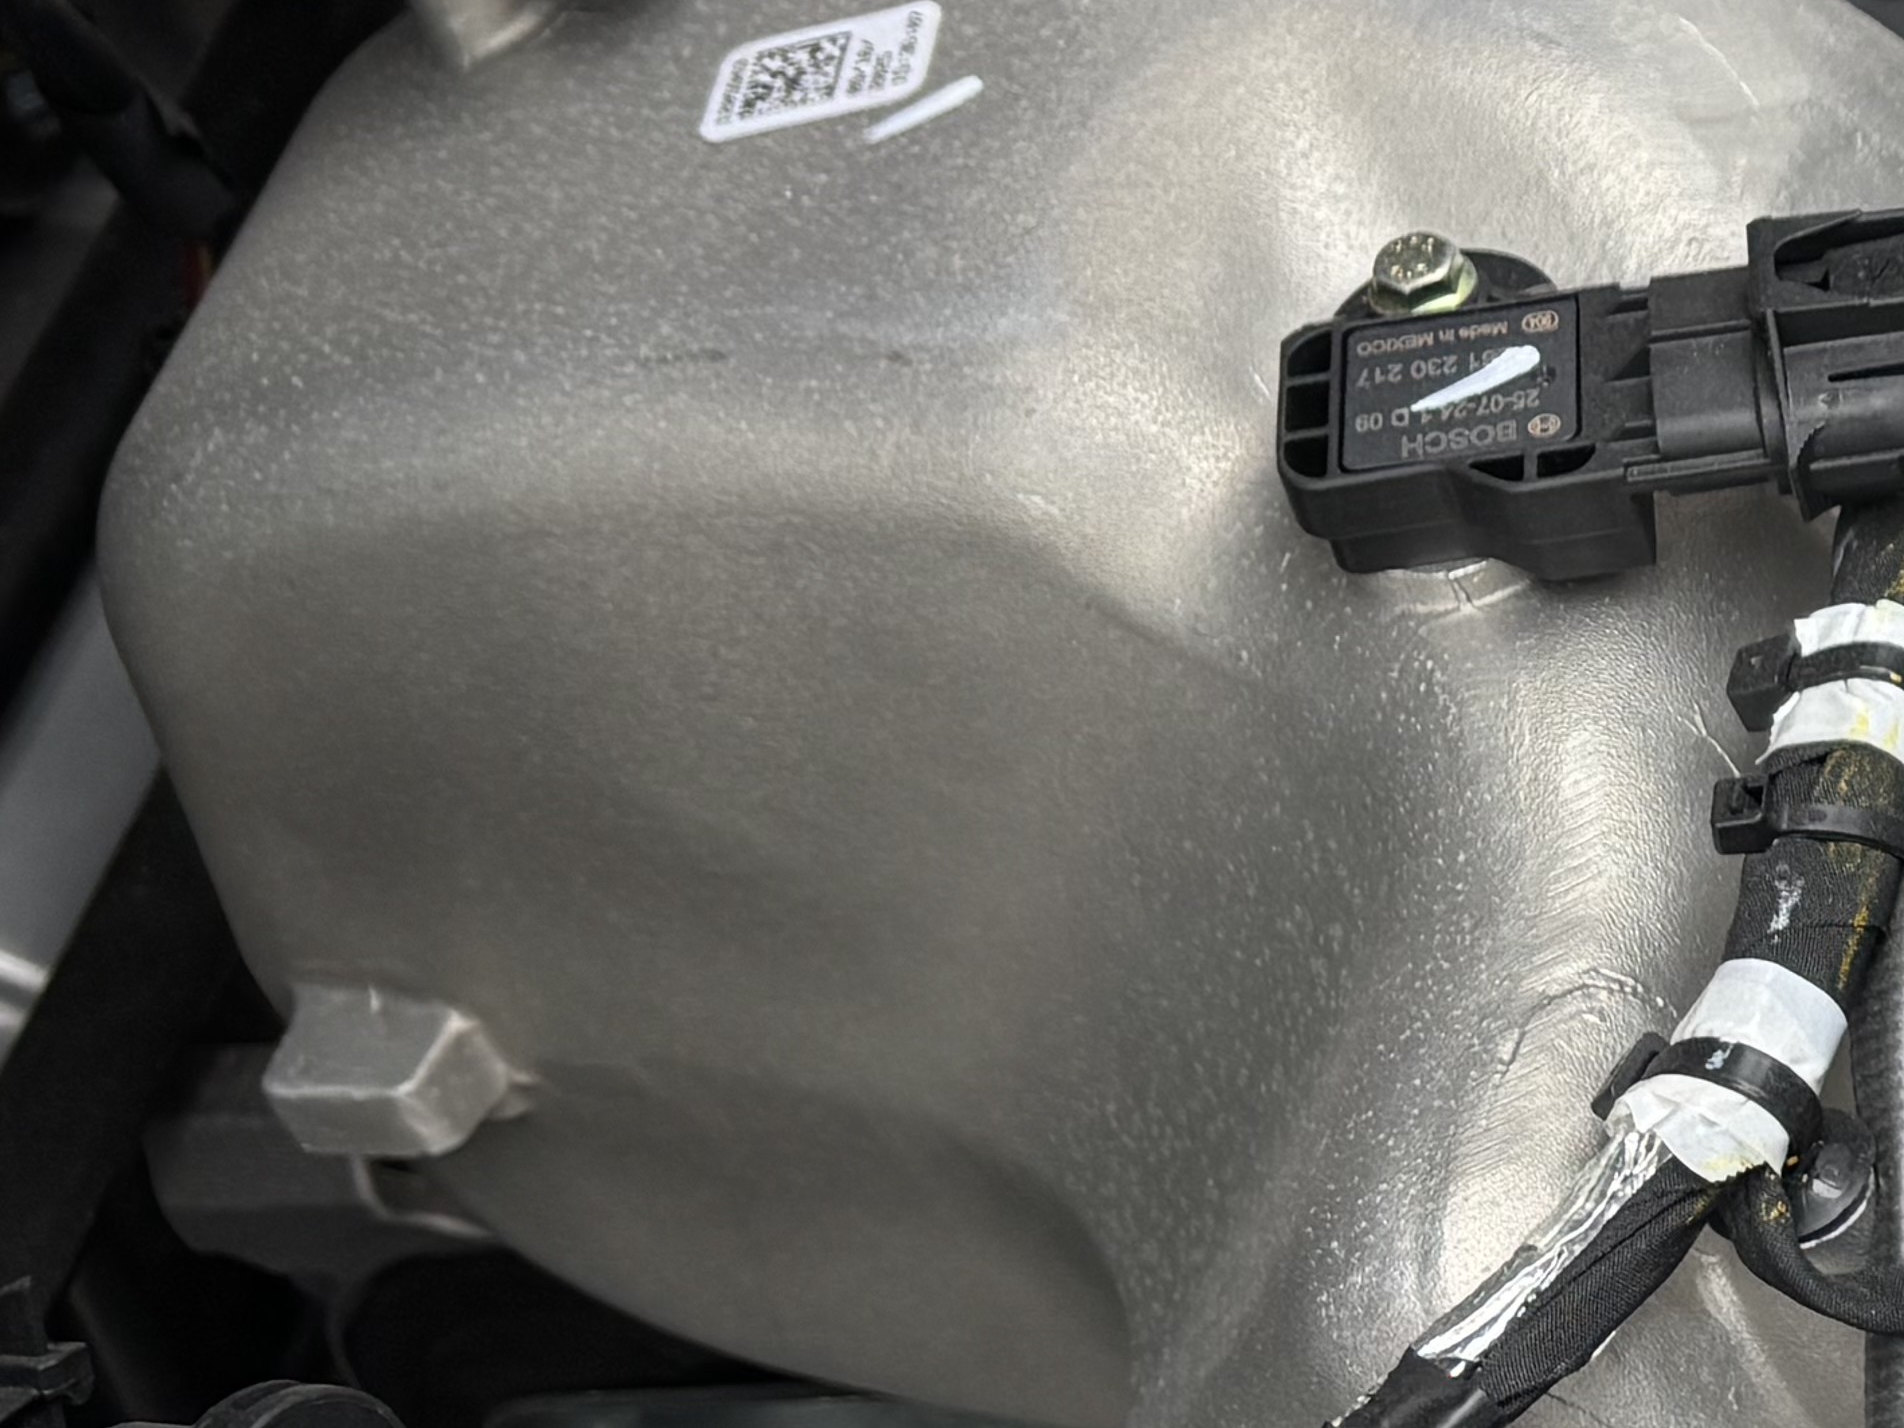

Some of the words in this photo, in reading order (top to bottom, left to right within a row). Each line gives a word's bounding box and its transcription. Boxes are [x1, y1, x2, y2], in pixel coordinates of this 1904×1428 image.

[1459, 321, 1508, 337] Made
[1357, 332, 1434, 355] MEXICO
[1356, 363, 1402, 388] 217
[1410, 355, 1458, 379] 230
[1401, 420, 1517, 457] BOSCH
